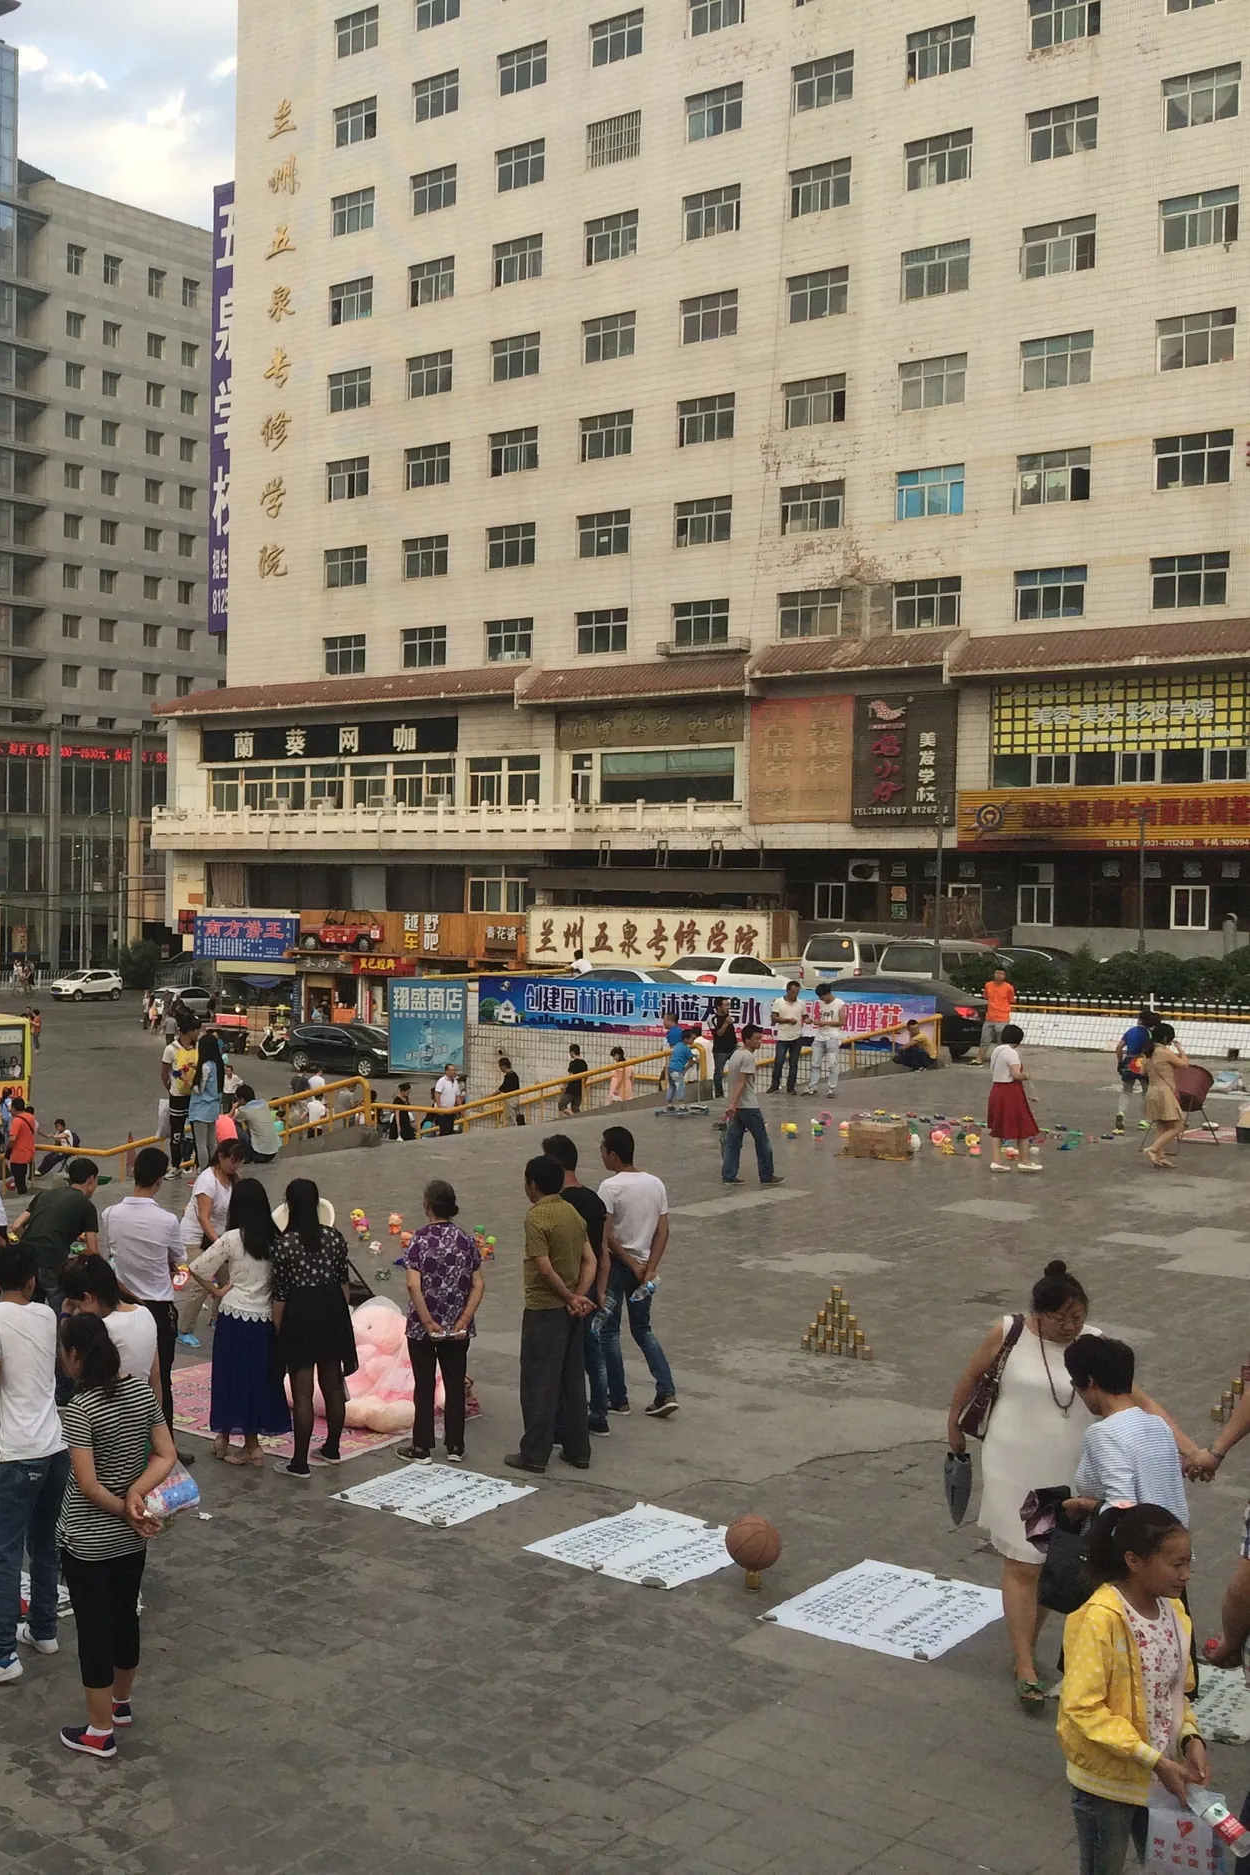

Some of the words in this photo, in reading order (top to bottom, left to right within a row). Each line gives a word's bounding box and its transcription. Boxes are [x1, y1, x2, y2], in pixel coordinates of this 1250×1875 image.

[258, 97, 302, 580] 兰州五泉专修学院
[233, 724, 418, 759] 蘭葵网咖
[916, 731, 937, 803] 美发学校
[912, 805, 949, 815] 812623
[203, 919, 285, 939] 南方饼王
[403, 914, 440, 932] 越野
[535, 915, 760, 961] 兰州五泉专修学院
[403, 932, 440, 951] 车吧
[524, 984, 635, 1018] 创建园林城市
